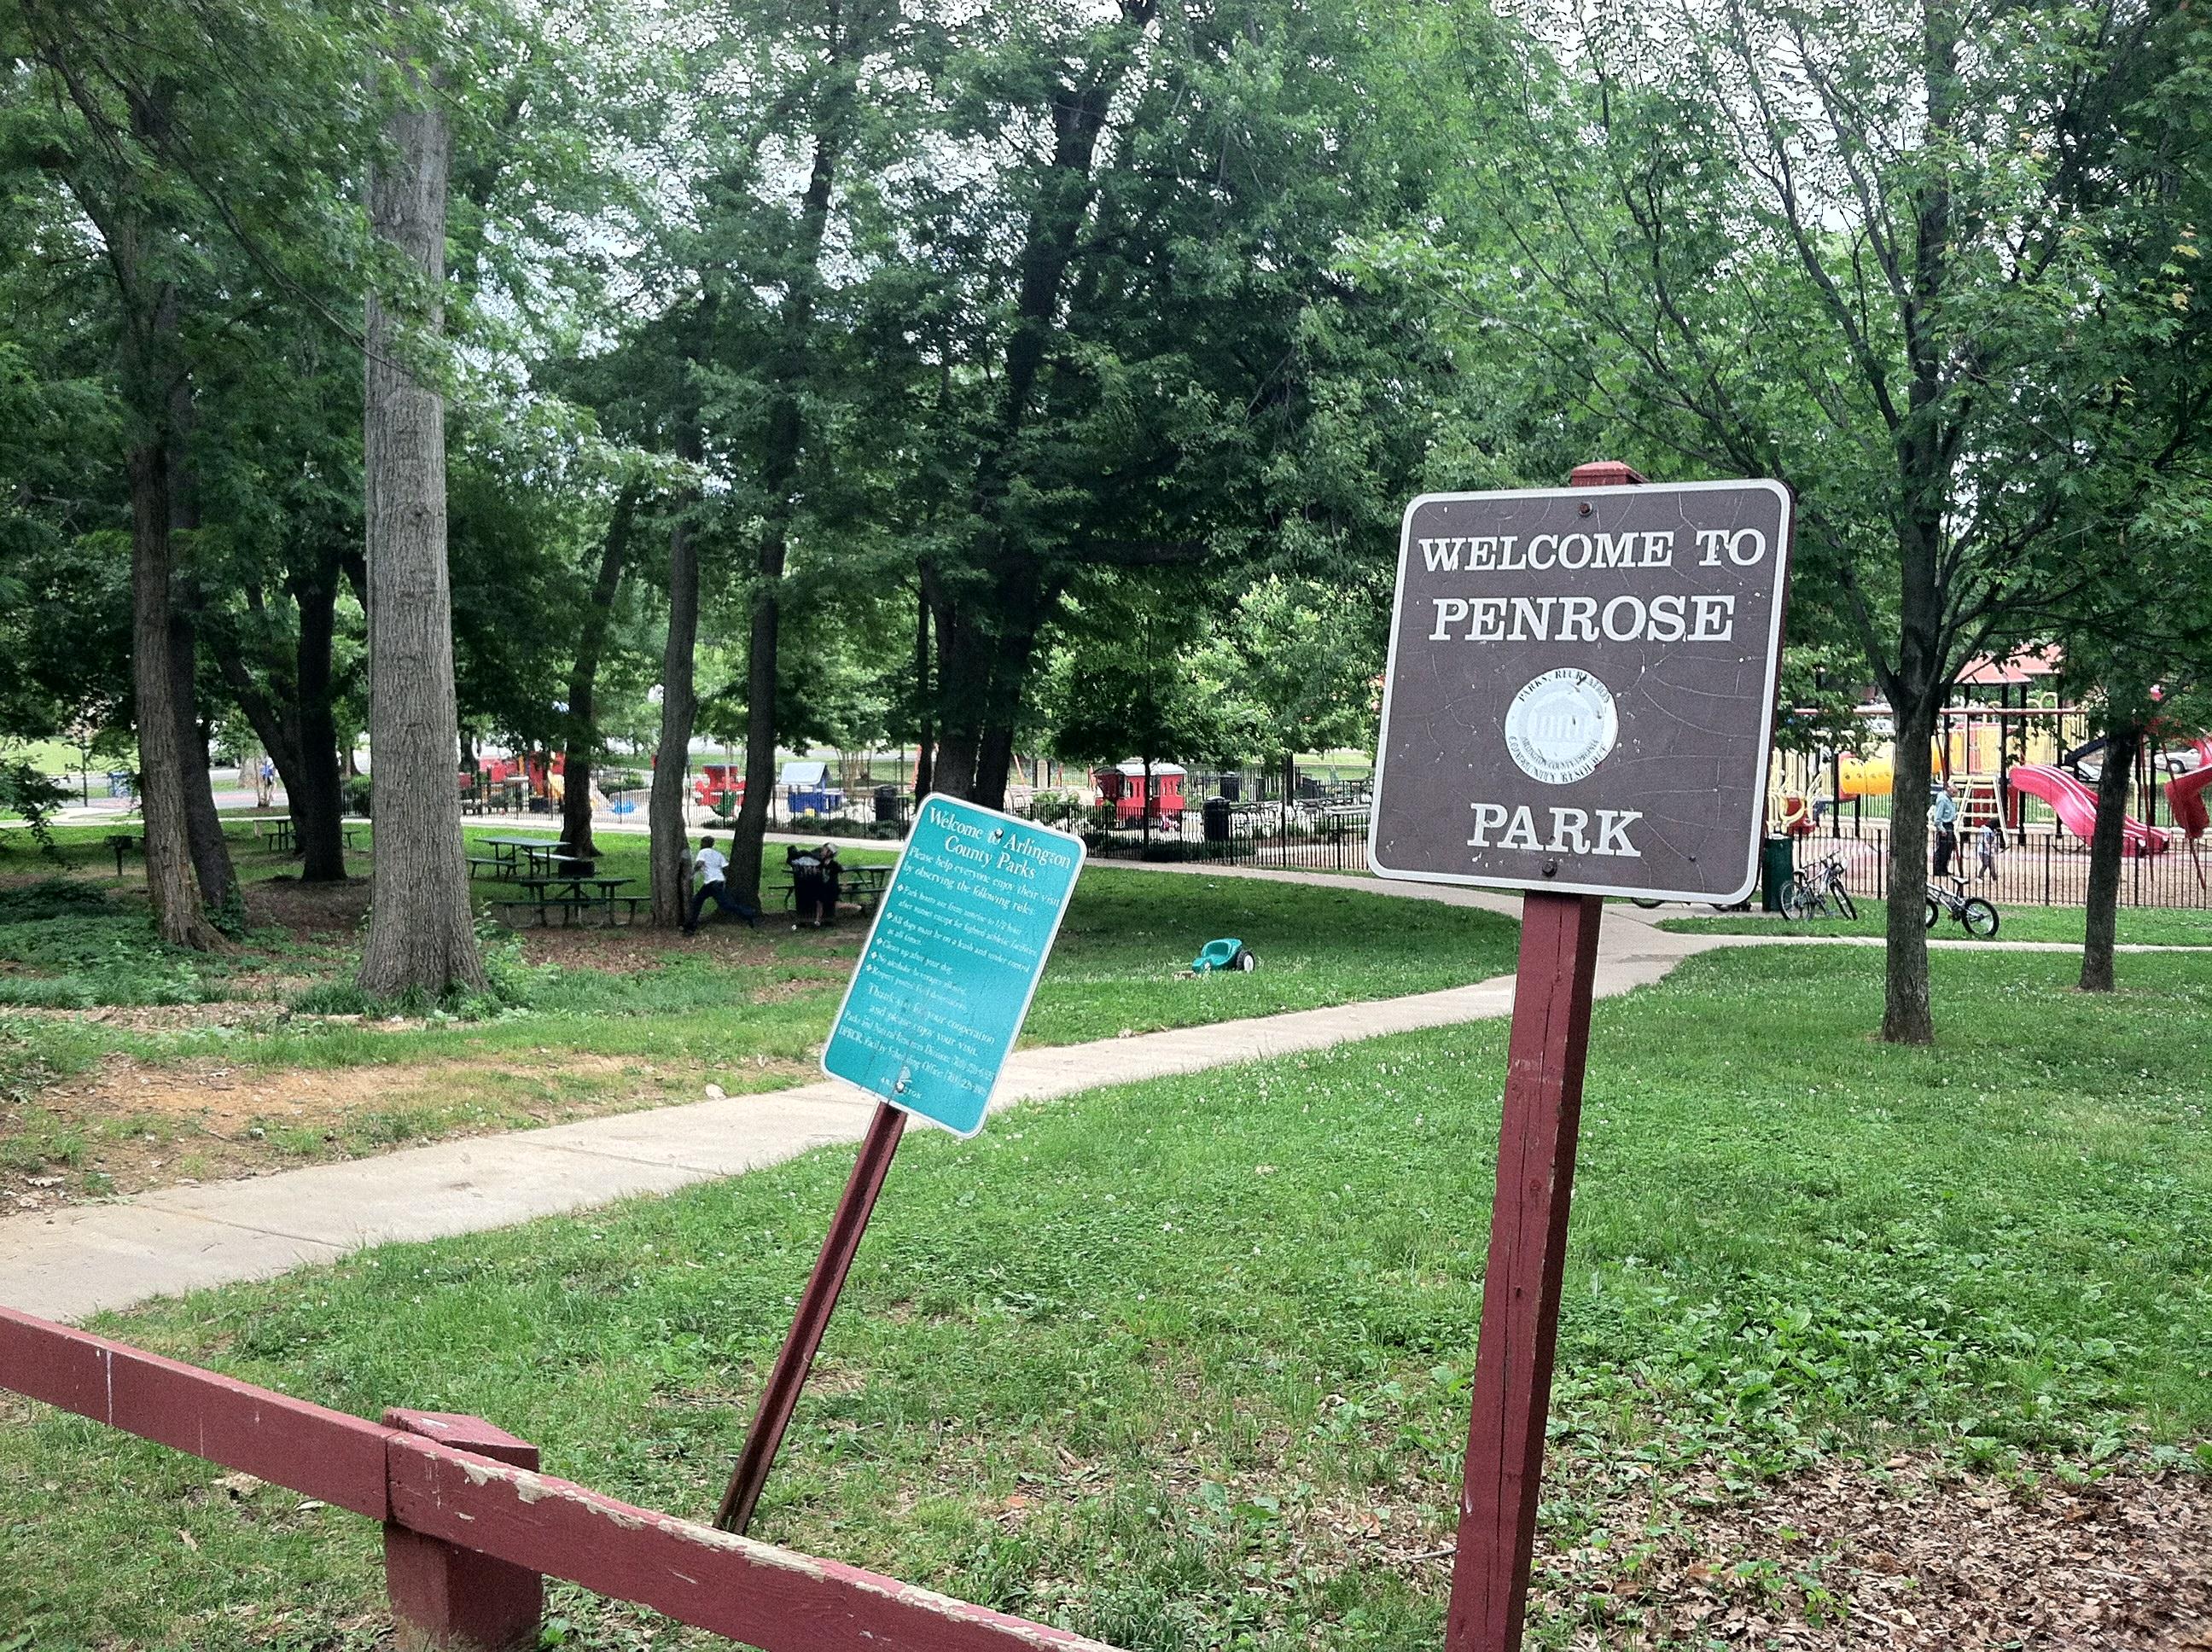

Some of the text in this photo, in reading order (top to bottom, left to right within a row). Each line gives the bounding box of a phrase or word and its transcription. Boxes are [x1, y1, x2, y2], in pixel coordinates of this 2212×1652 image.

[1418, 528, 1767, 572] WELCOME TO
[1429, 595, 1735, 642] PENROSE
[930, 807, 1072, 870] Welcome to Arlington
[1467, 803, 1643, 857] PARK
[909, 846, 934, 863] Please
[935, 856, 953, 871] help
[953, 864, 990, 885] everyone
[992, 877, 1014, 893] enjoy
[1017, 883, 1039, 899] their
[945, 835, 1035, 879] County Parks
[902, 860, 914, 874] by
[914, 865, 955, 888] observing
[957, 880, 971, 893] the
[972, 885, 1010, 909] following
